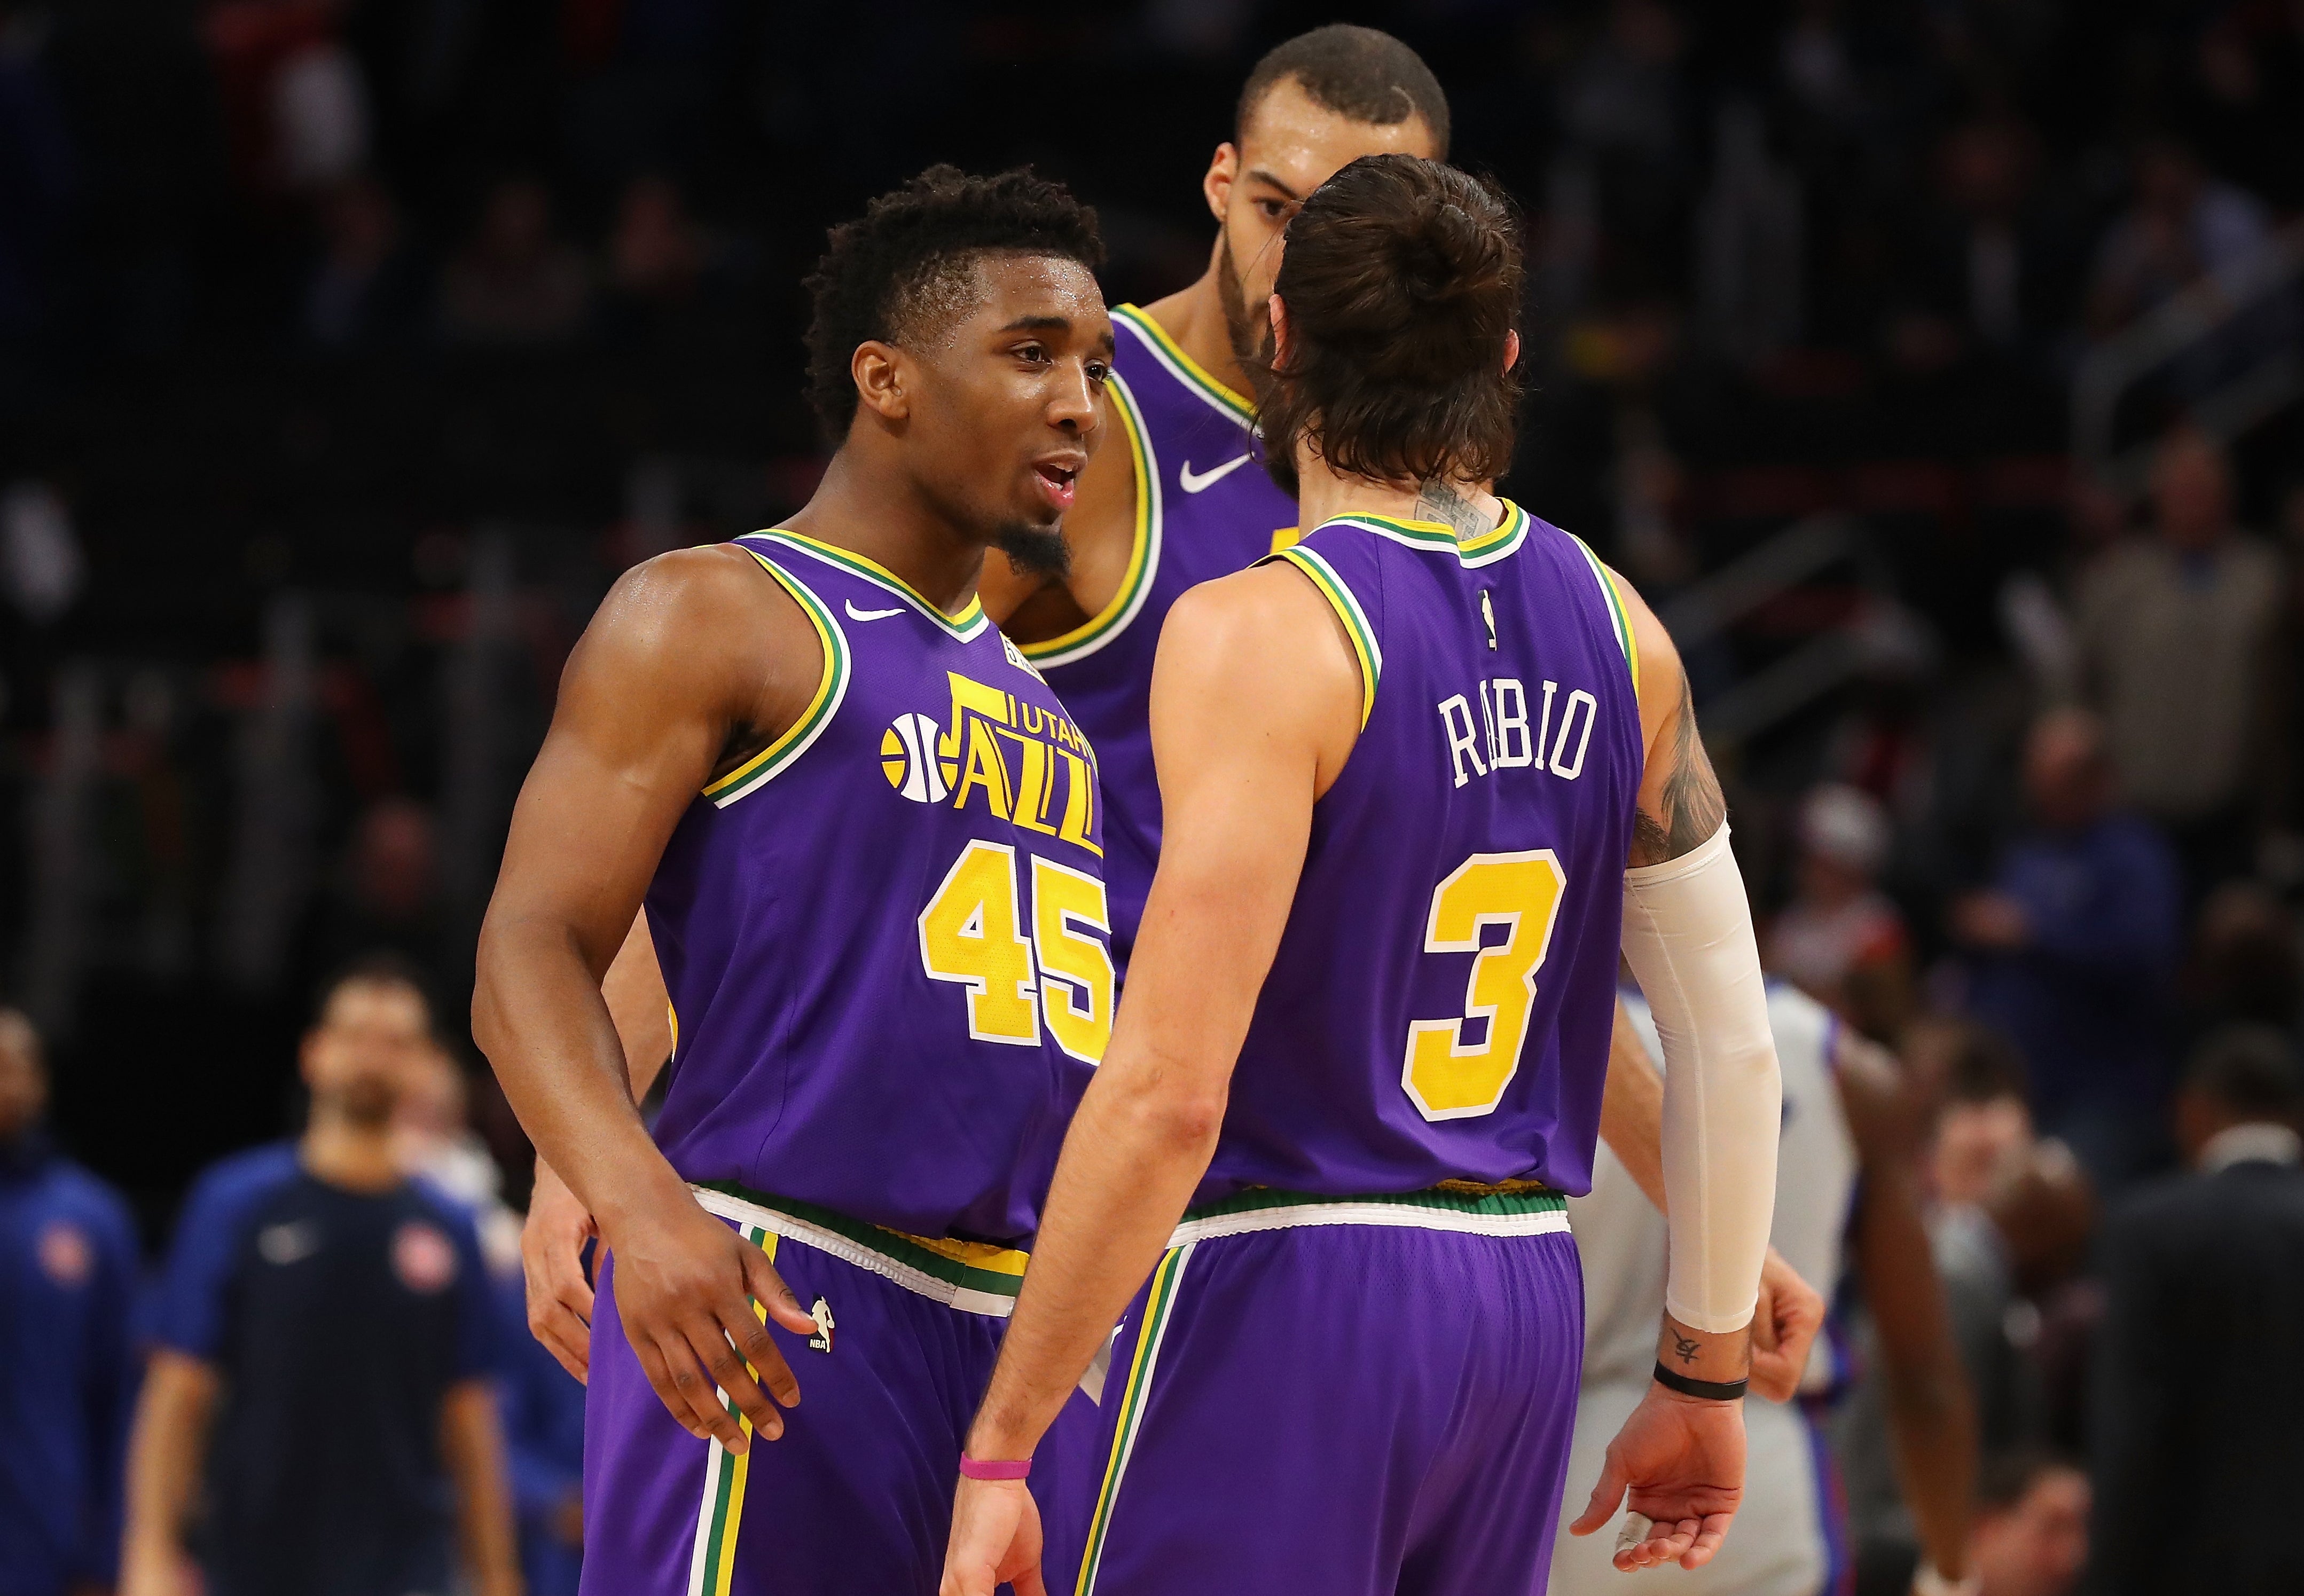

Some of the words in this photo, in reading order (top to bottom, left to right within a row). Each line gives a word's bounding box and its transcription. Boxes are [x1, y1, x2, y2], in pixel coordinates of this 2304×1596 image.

[1022, 702, 1088, 757] UTAH
[918, 839, 1116, 1066] 45
[1401, 848, 1567, 1122] 3
[810, 1339, 826, 1349] NBA
